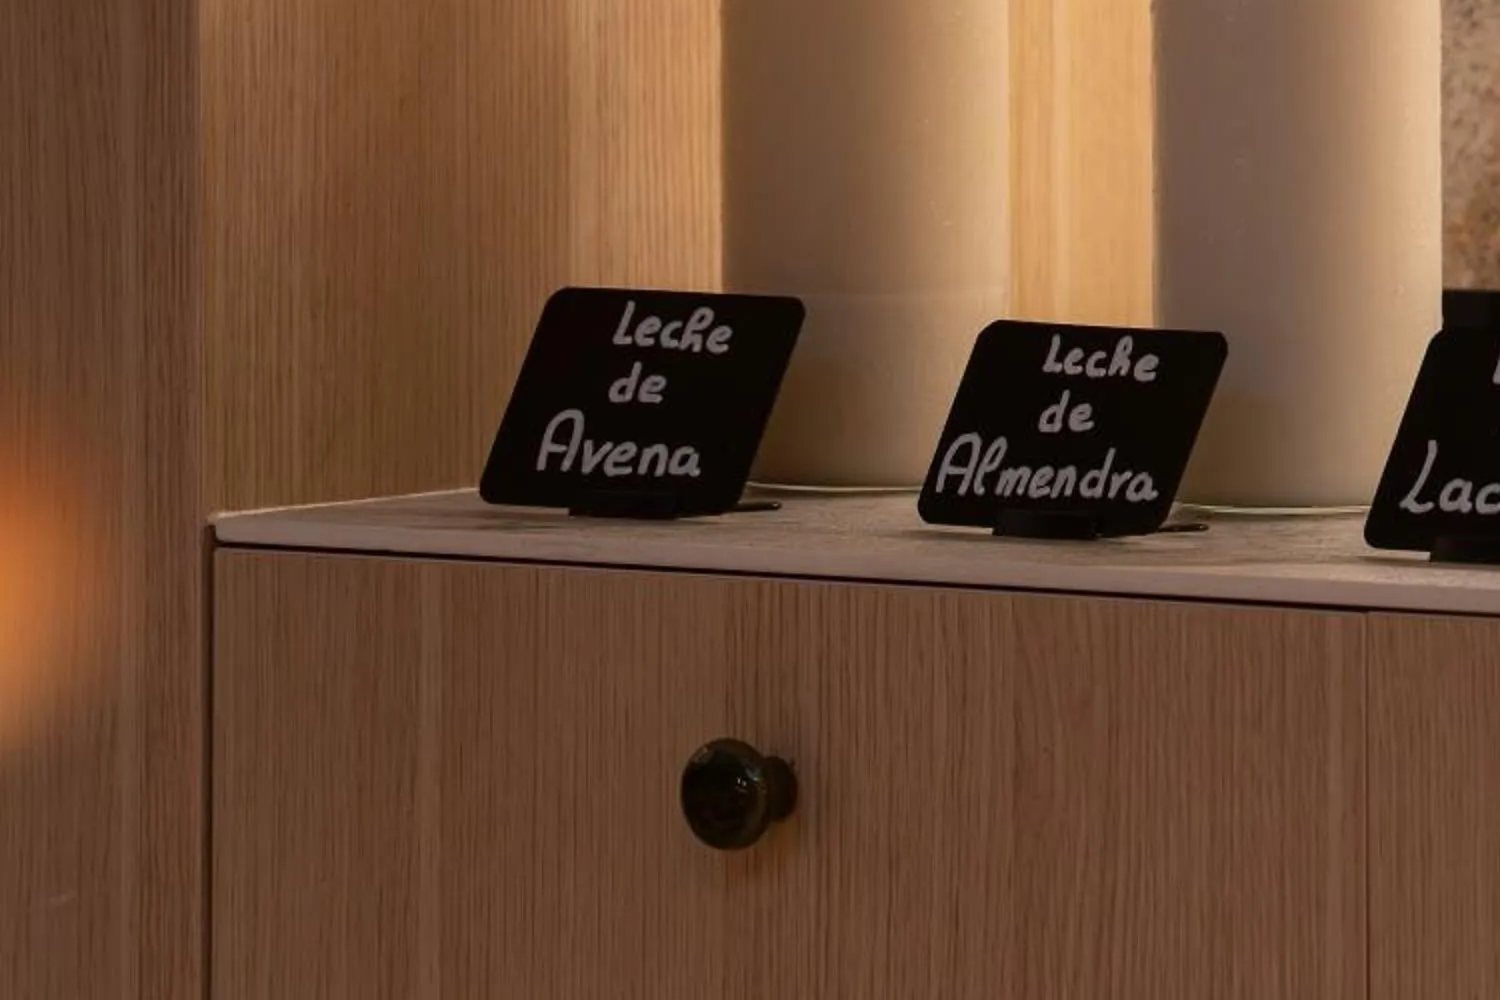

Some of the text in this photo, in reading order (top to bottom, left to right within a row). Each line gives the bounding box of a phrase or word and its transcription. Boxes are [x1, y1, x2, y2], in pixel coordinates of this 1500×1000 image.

[613, 301, 732, 353] Leche
[609, 362, 666, 403] de
[1043, 335, 1158, 381] Leche
[1039, 390, 1094, 432] de
[537, 410, 700, 476] Avena
[934, 432, 1158, 501] Almendra
